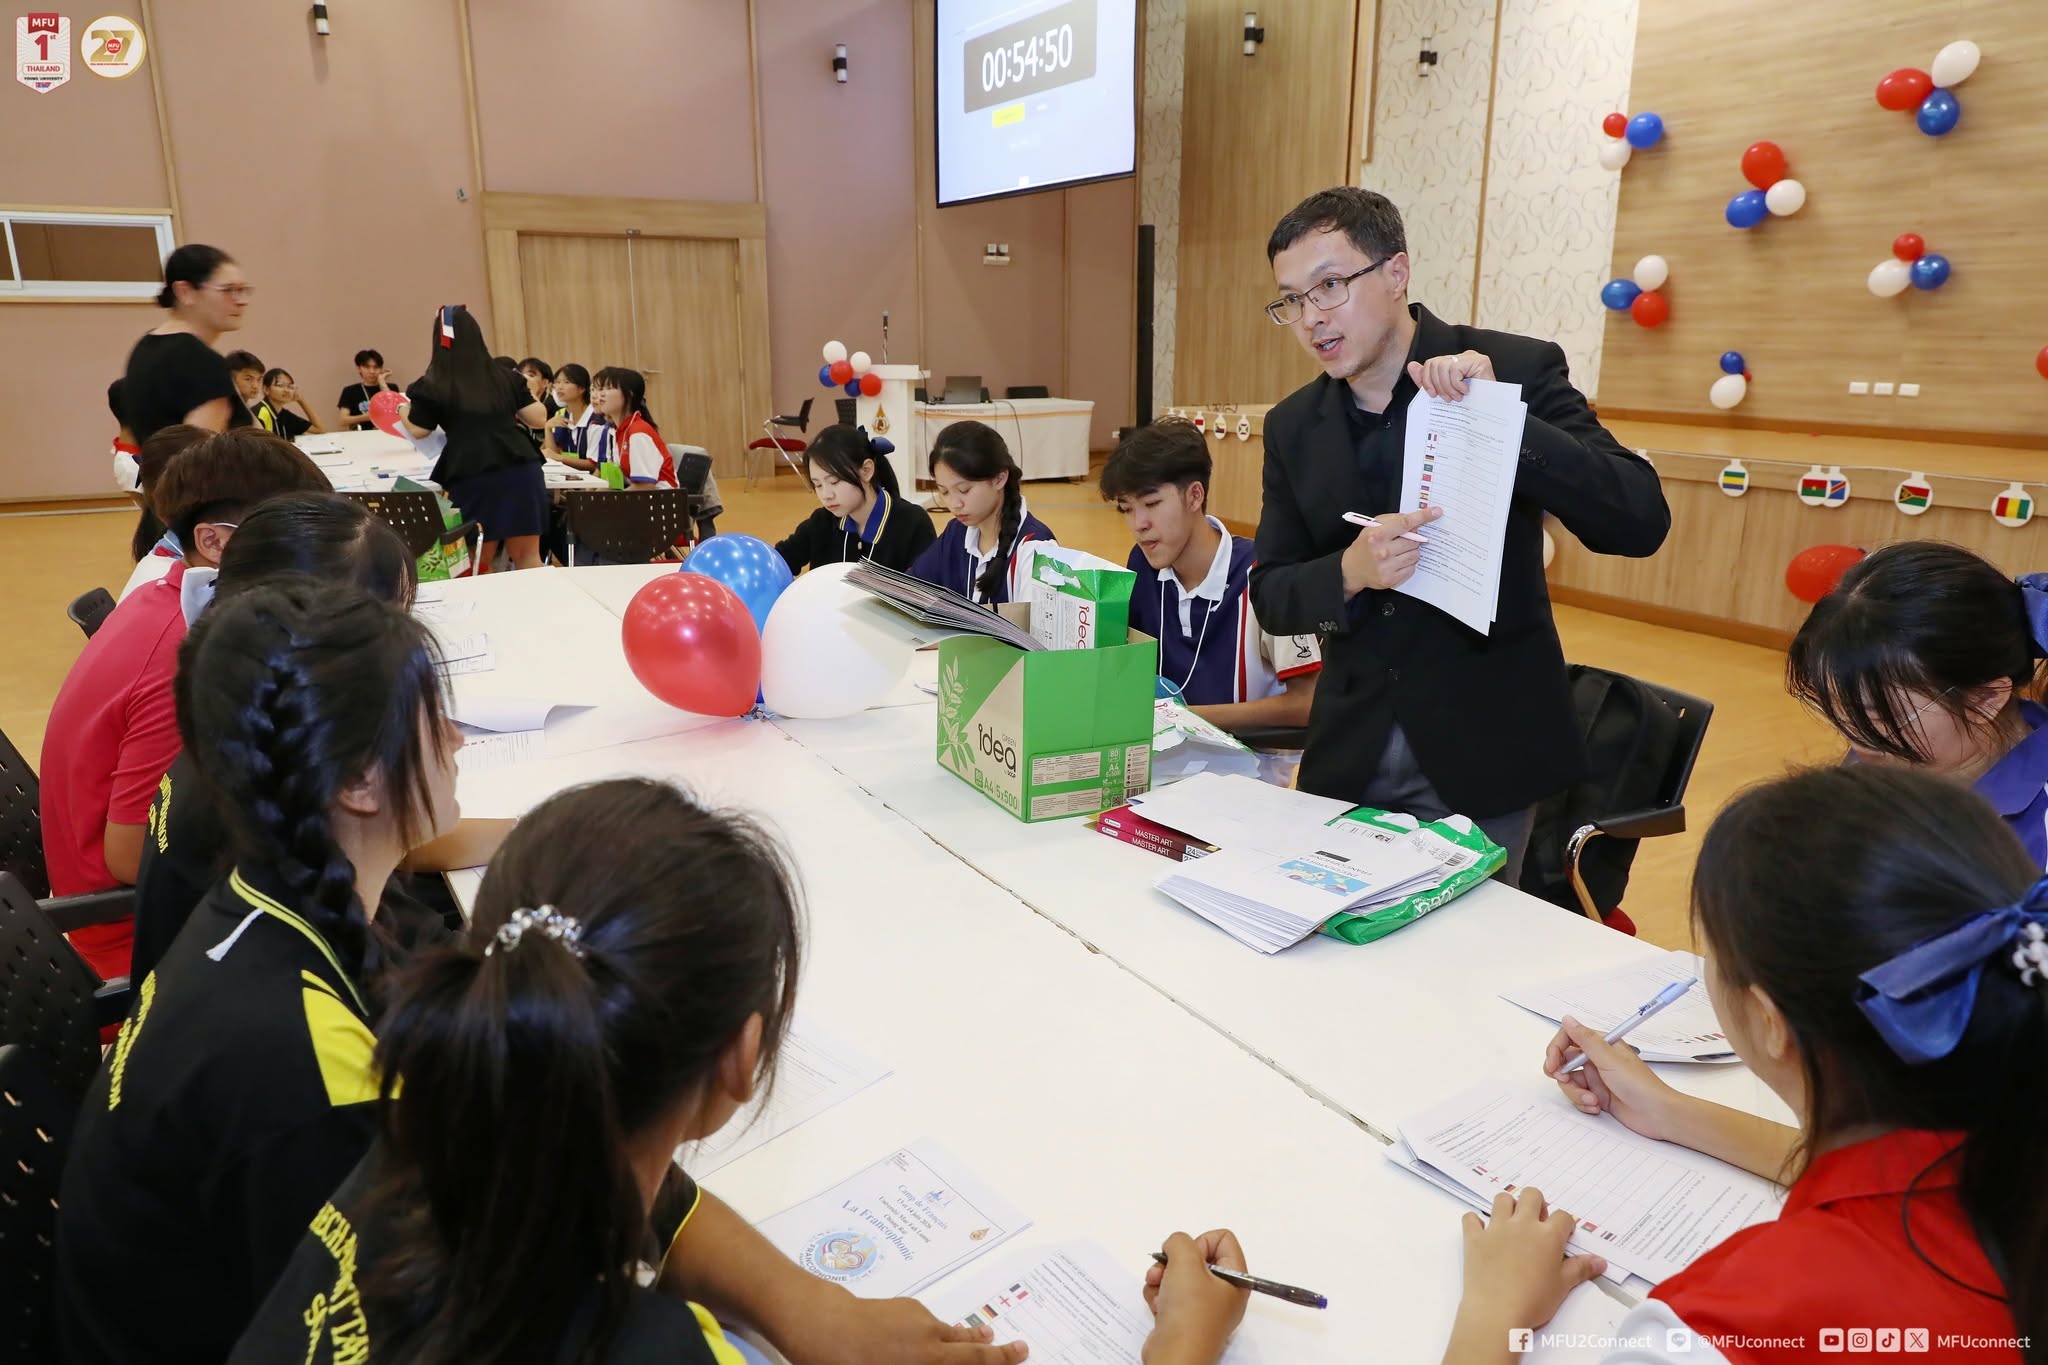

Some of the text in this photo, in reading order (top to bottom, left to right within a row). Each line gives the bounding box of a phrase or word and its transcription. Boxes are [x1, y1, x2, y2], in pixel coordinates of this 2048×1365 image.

[982, 24, 1073, 92] 00:54:50
[978, 723, 1016, 772] idea
[1002, 734, 1016, 747] GREEN
[1110, 750, 1118, 758] 80
[1109, 762, 1119, 771] A4
[984, 777, 994, 794] A4
[996, 784, 1018, 810] 5x500
[1132, 838, 1170, 857] MASTER ART
[1135, 828, 1173, 848] MASTER ART
[1187, 847, 1197, 856] 24
[898, 1184, 916, 1201] Camp
[842, 1199, 914, 1261] La Francophonie
[805, 1244, 848, 1281] FRANCOPHONIE
